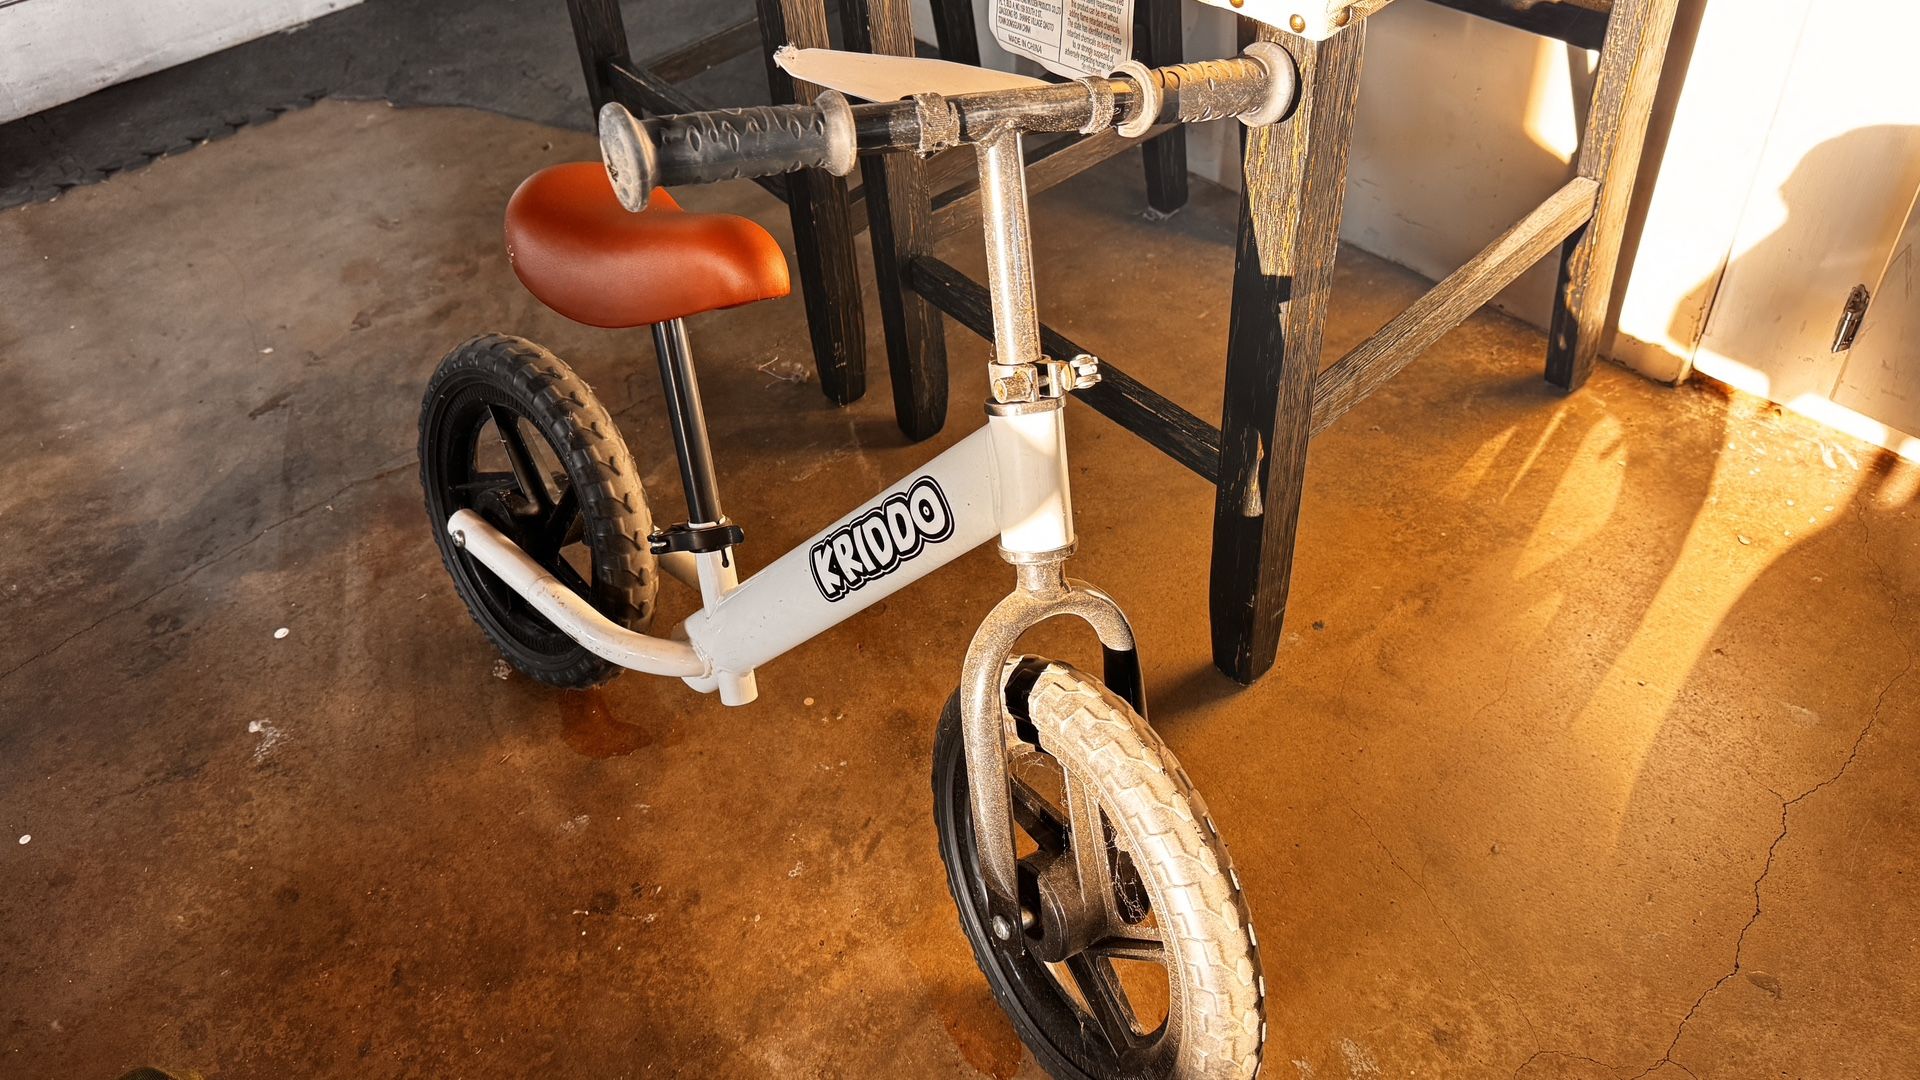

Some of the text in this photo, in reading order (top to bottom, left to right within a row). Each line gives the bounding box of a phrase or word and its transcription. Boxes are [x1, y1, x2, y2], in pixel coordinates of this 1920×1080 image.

[1076, 2, 1088, 12] product
[1008, 34, 1020, 46] MADE
[1026, 41, 1042, 54] CHINA
[811, 476, 955, 601] KRIDDO
